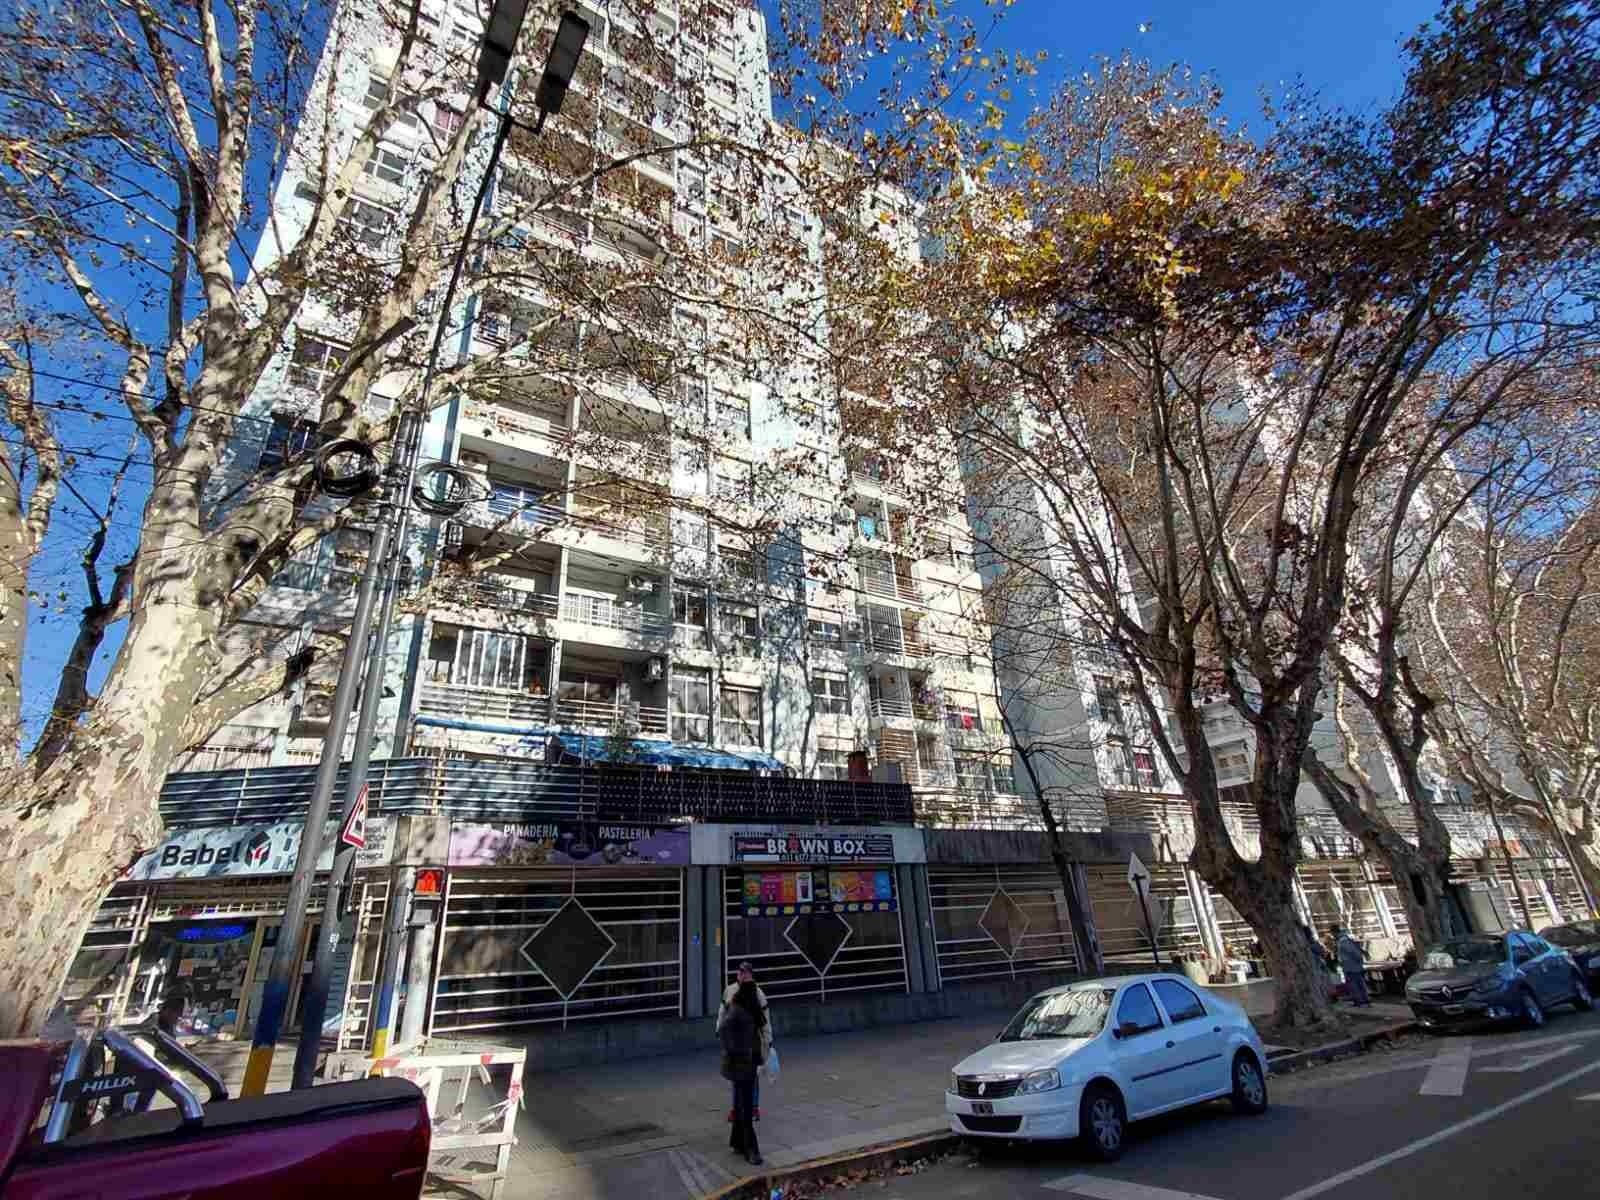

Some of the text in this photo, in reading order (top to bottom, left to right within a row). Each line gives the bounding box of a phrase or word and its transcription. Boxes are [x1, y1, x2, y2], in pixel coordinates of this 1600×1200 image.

[503, 824, 650, 841] PANADERÍA PASTELERÍA
[160, 841, 241, 867] Babel
[834, 839, 866, 855] BOX
[82, 1075, 137, 1093] HILUX
